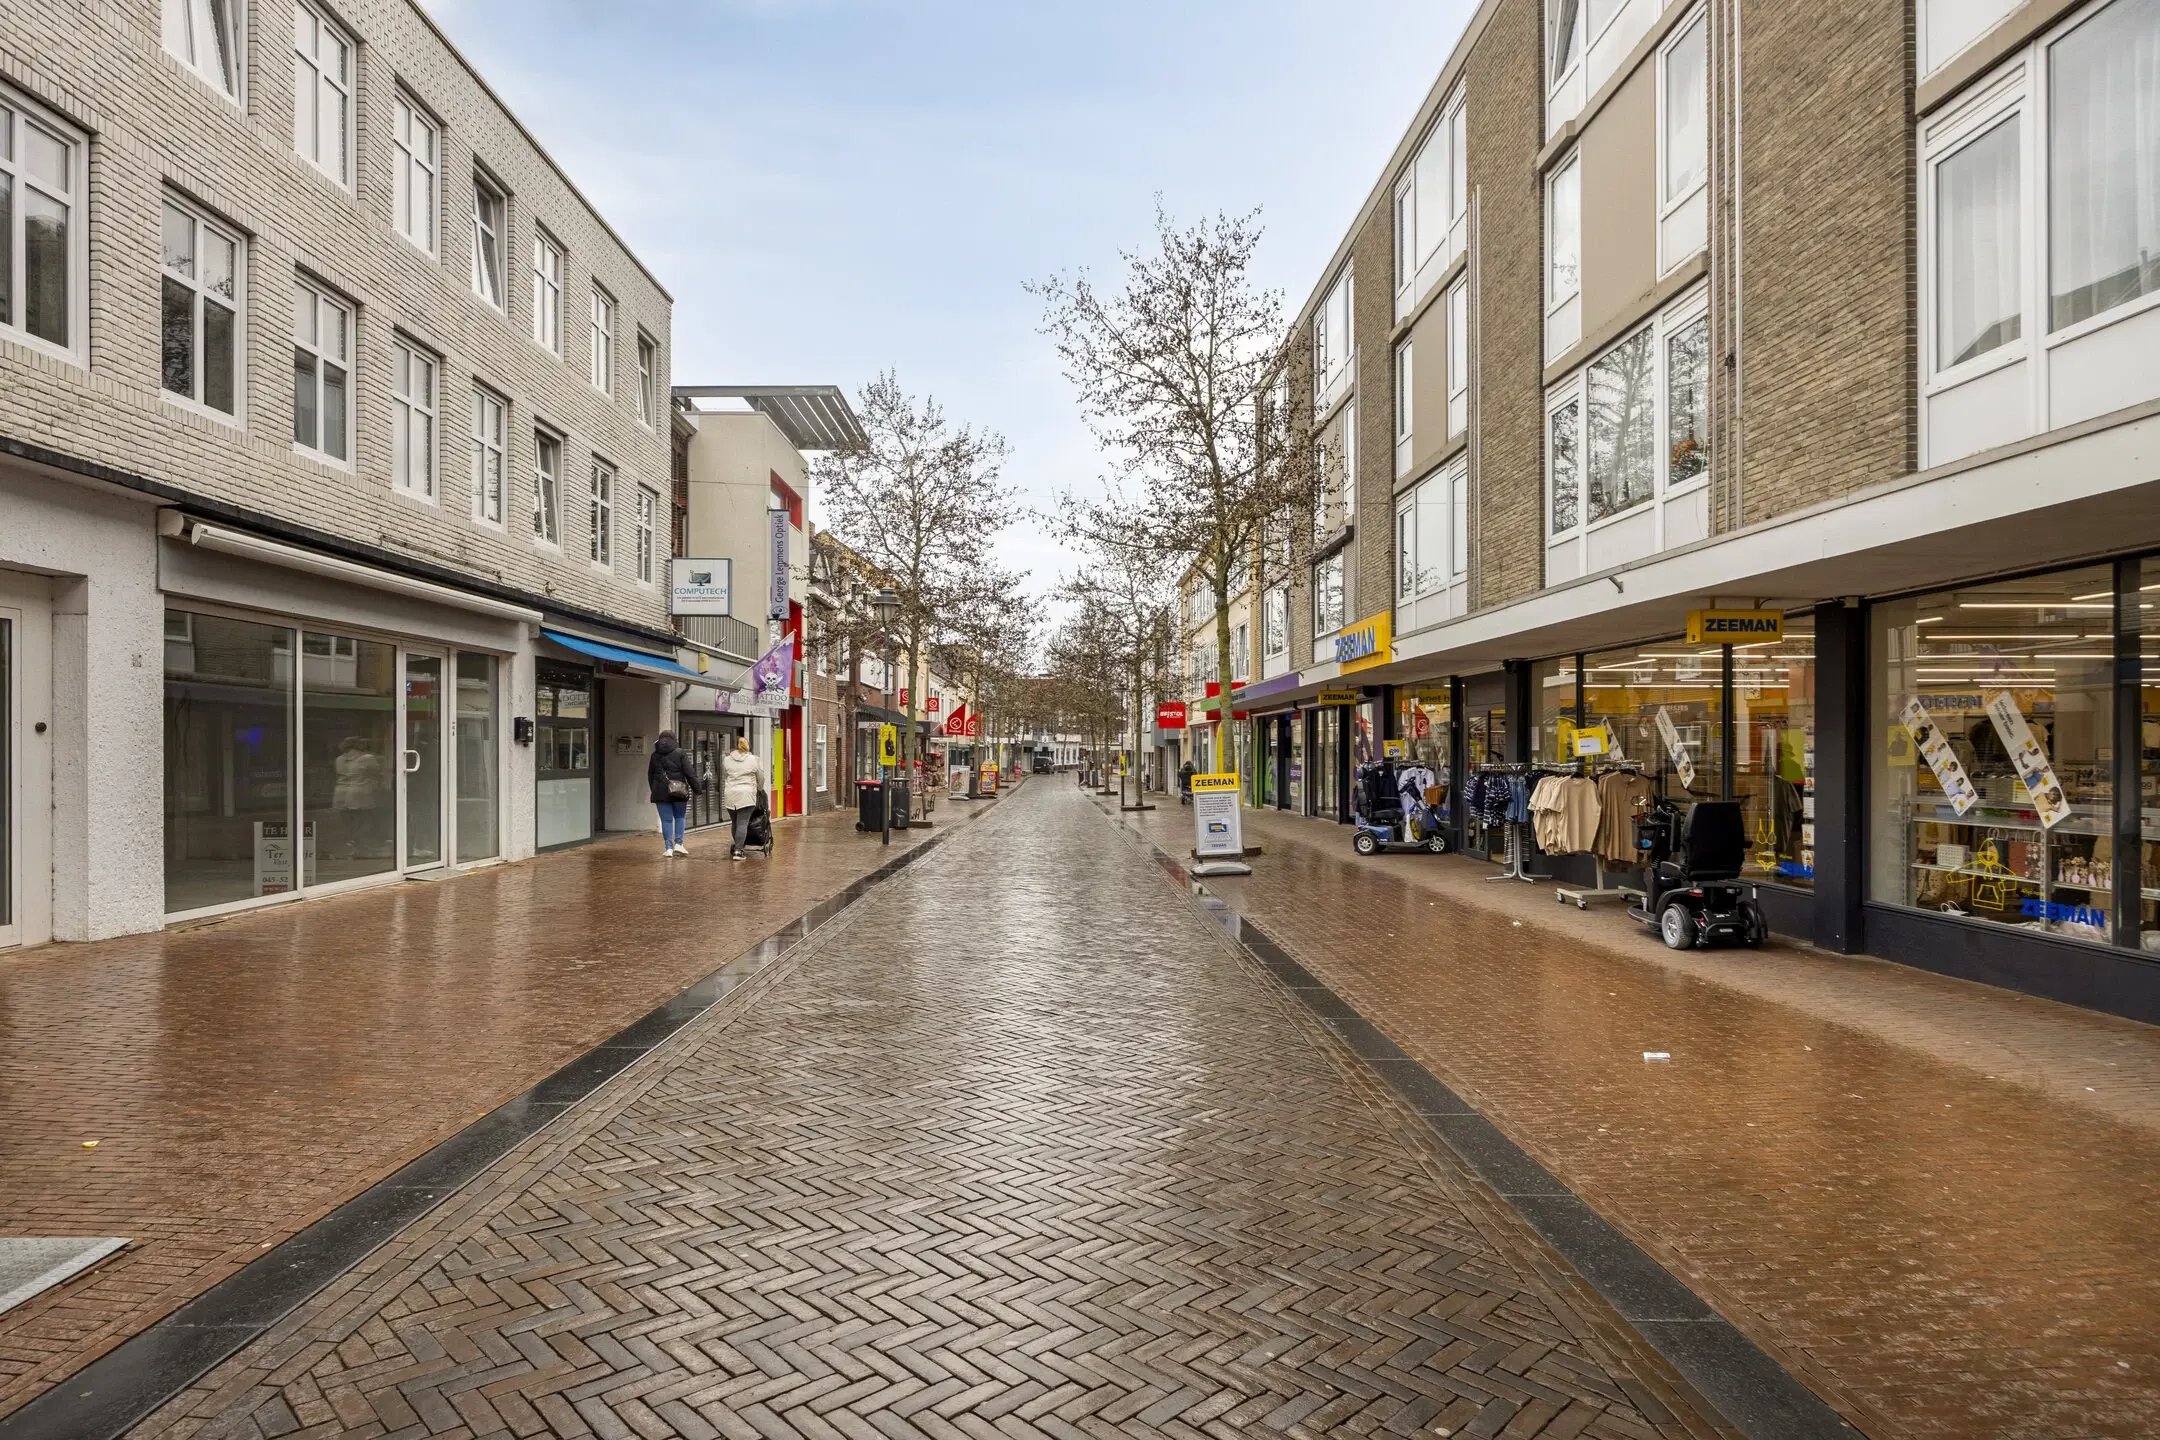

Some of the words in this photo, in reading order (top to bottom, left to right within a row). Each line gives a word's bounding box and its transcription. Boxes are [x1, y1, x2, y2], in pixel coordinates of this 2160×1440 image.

[775, 514, 786, 538] Optiek
[674, 587, 727, 595] COMPUTECH
[775, 577, 786, 603] George
[1705, 618, 1778, 632] ZEEMAN
[1335, 625, 1376, 664] ZEEMAN
[1322, 693, 1355, 701] ZEEMAN
[1195, 778, 1235, 787] ZEEMAN
[264, 827, 277, 835] TE
[280, 827, 312, 835] HR
[2020, 897, 2105, 928] ZEEMAN
